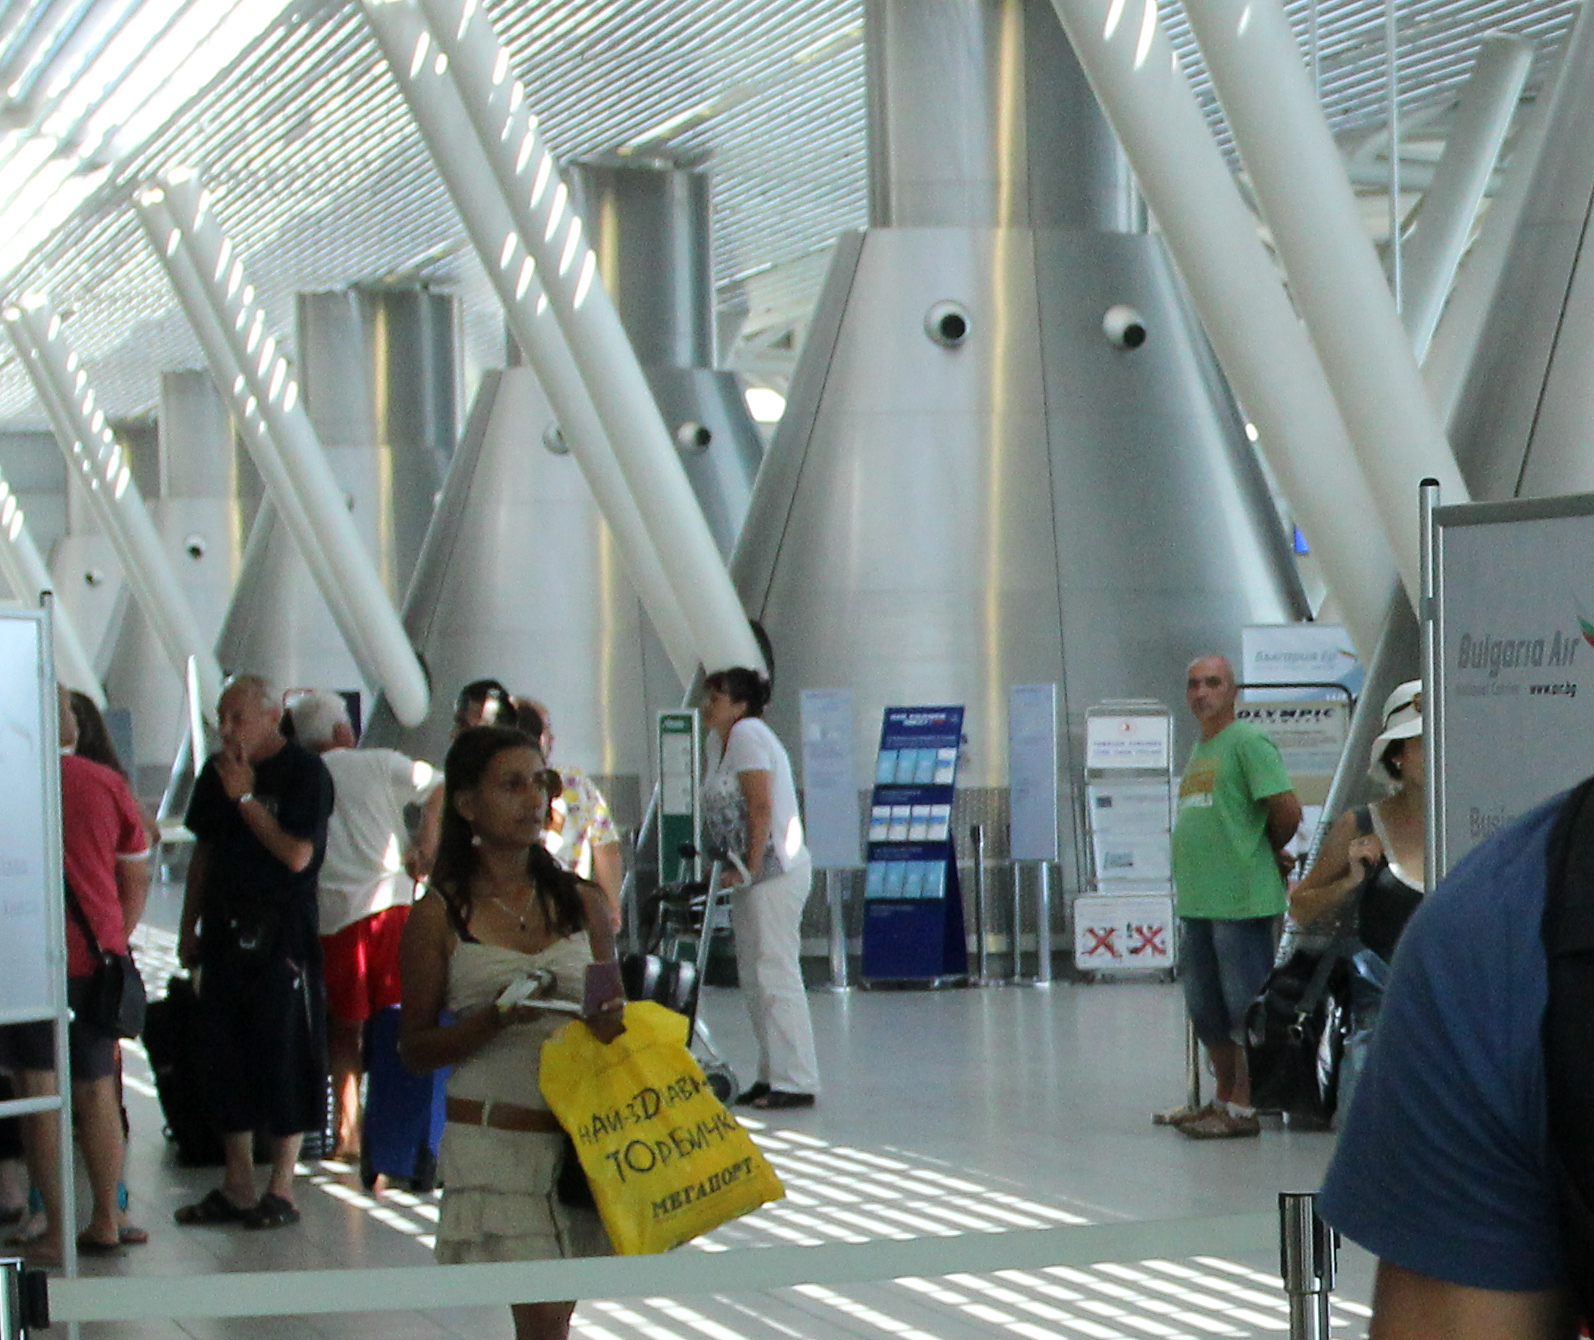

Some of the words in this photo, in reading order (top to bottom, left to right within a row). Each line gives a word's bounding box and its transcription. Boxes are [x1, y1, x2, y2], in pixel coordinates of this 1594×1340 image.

[1457, 632, 1545, 678] Bulgaria
[1547, 629, 1582, 667] Air
[1237, 707, 1335, 720] OLYMPIC
